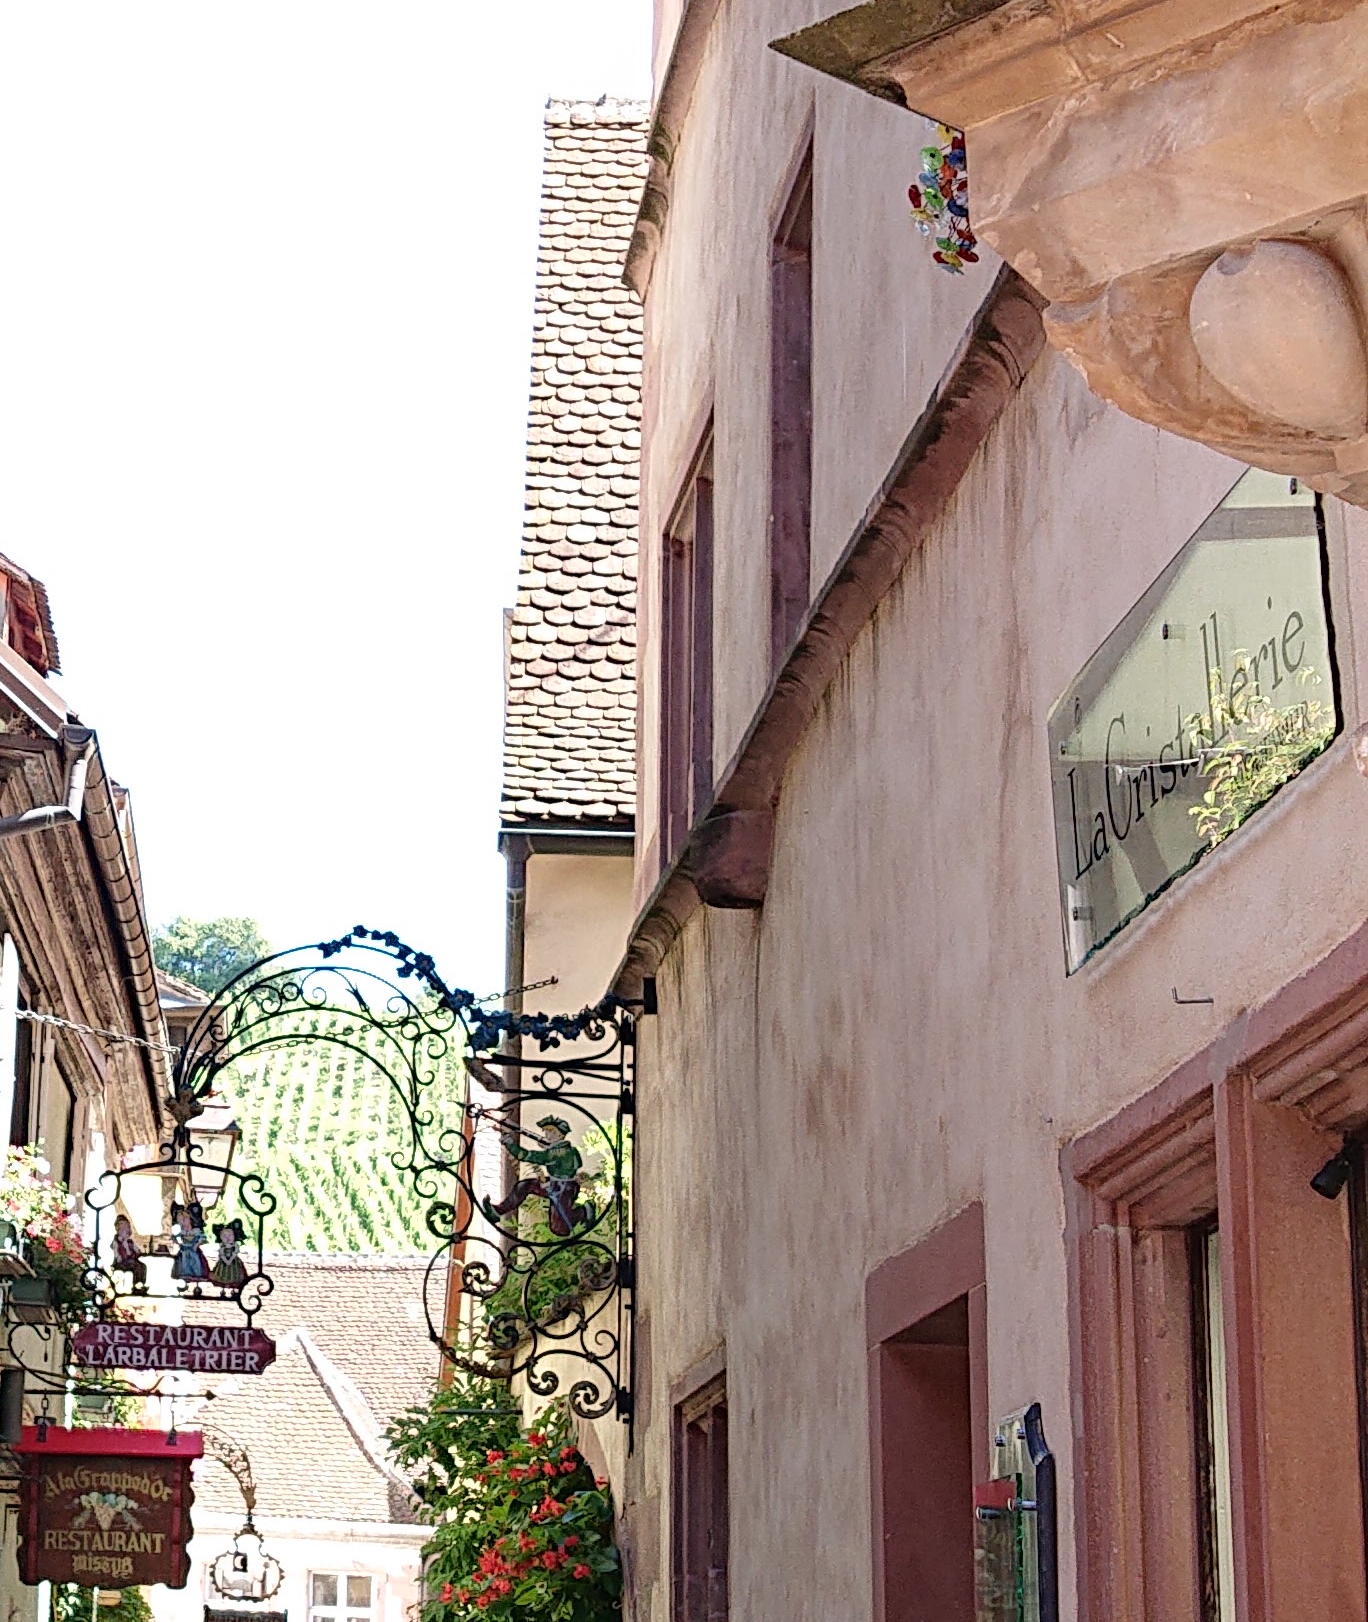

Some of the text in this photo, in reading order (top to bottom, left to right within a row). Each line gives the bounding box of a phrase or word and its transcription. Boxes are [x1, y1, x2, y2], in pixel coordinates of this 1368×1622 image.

[1067, 767, 1110, 881] La
[96, 1324, 253, 1350] RESTAURANT
[44, 1530, 165, 1554] RESTAURANT
